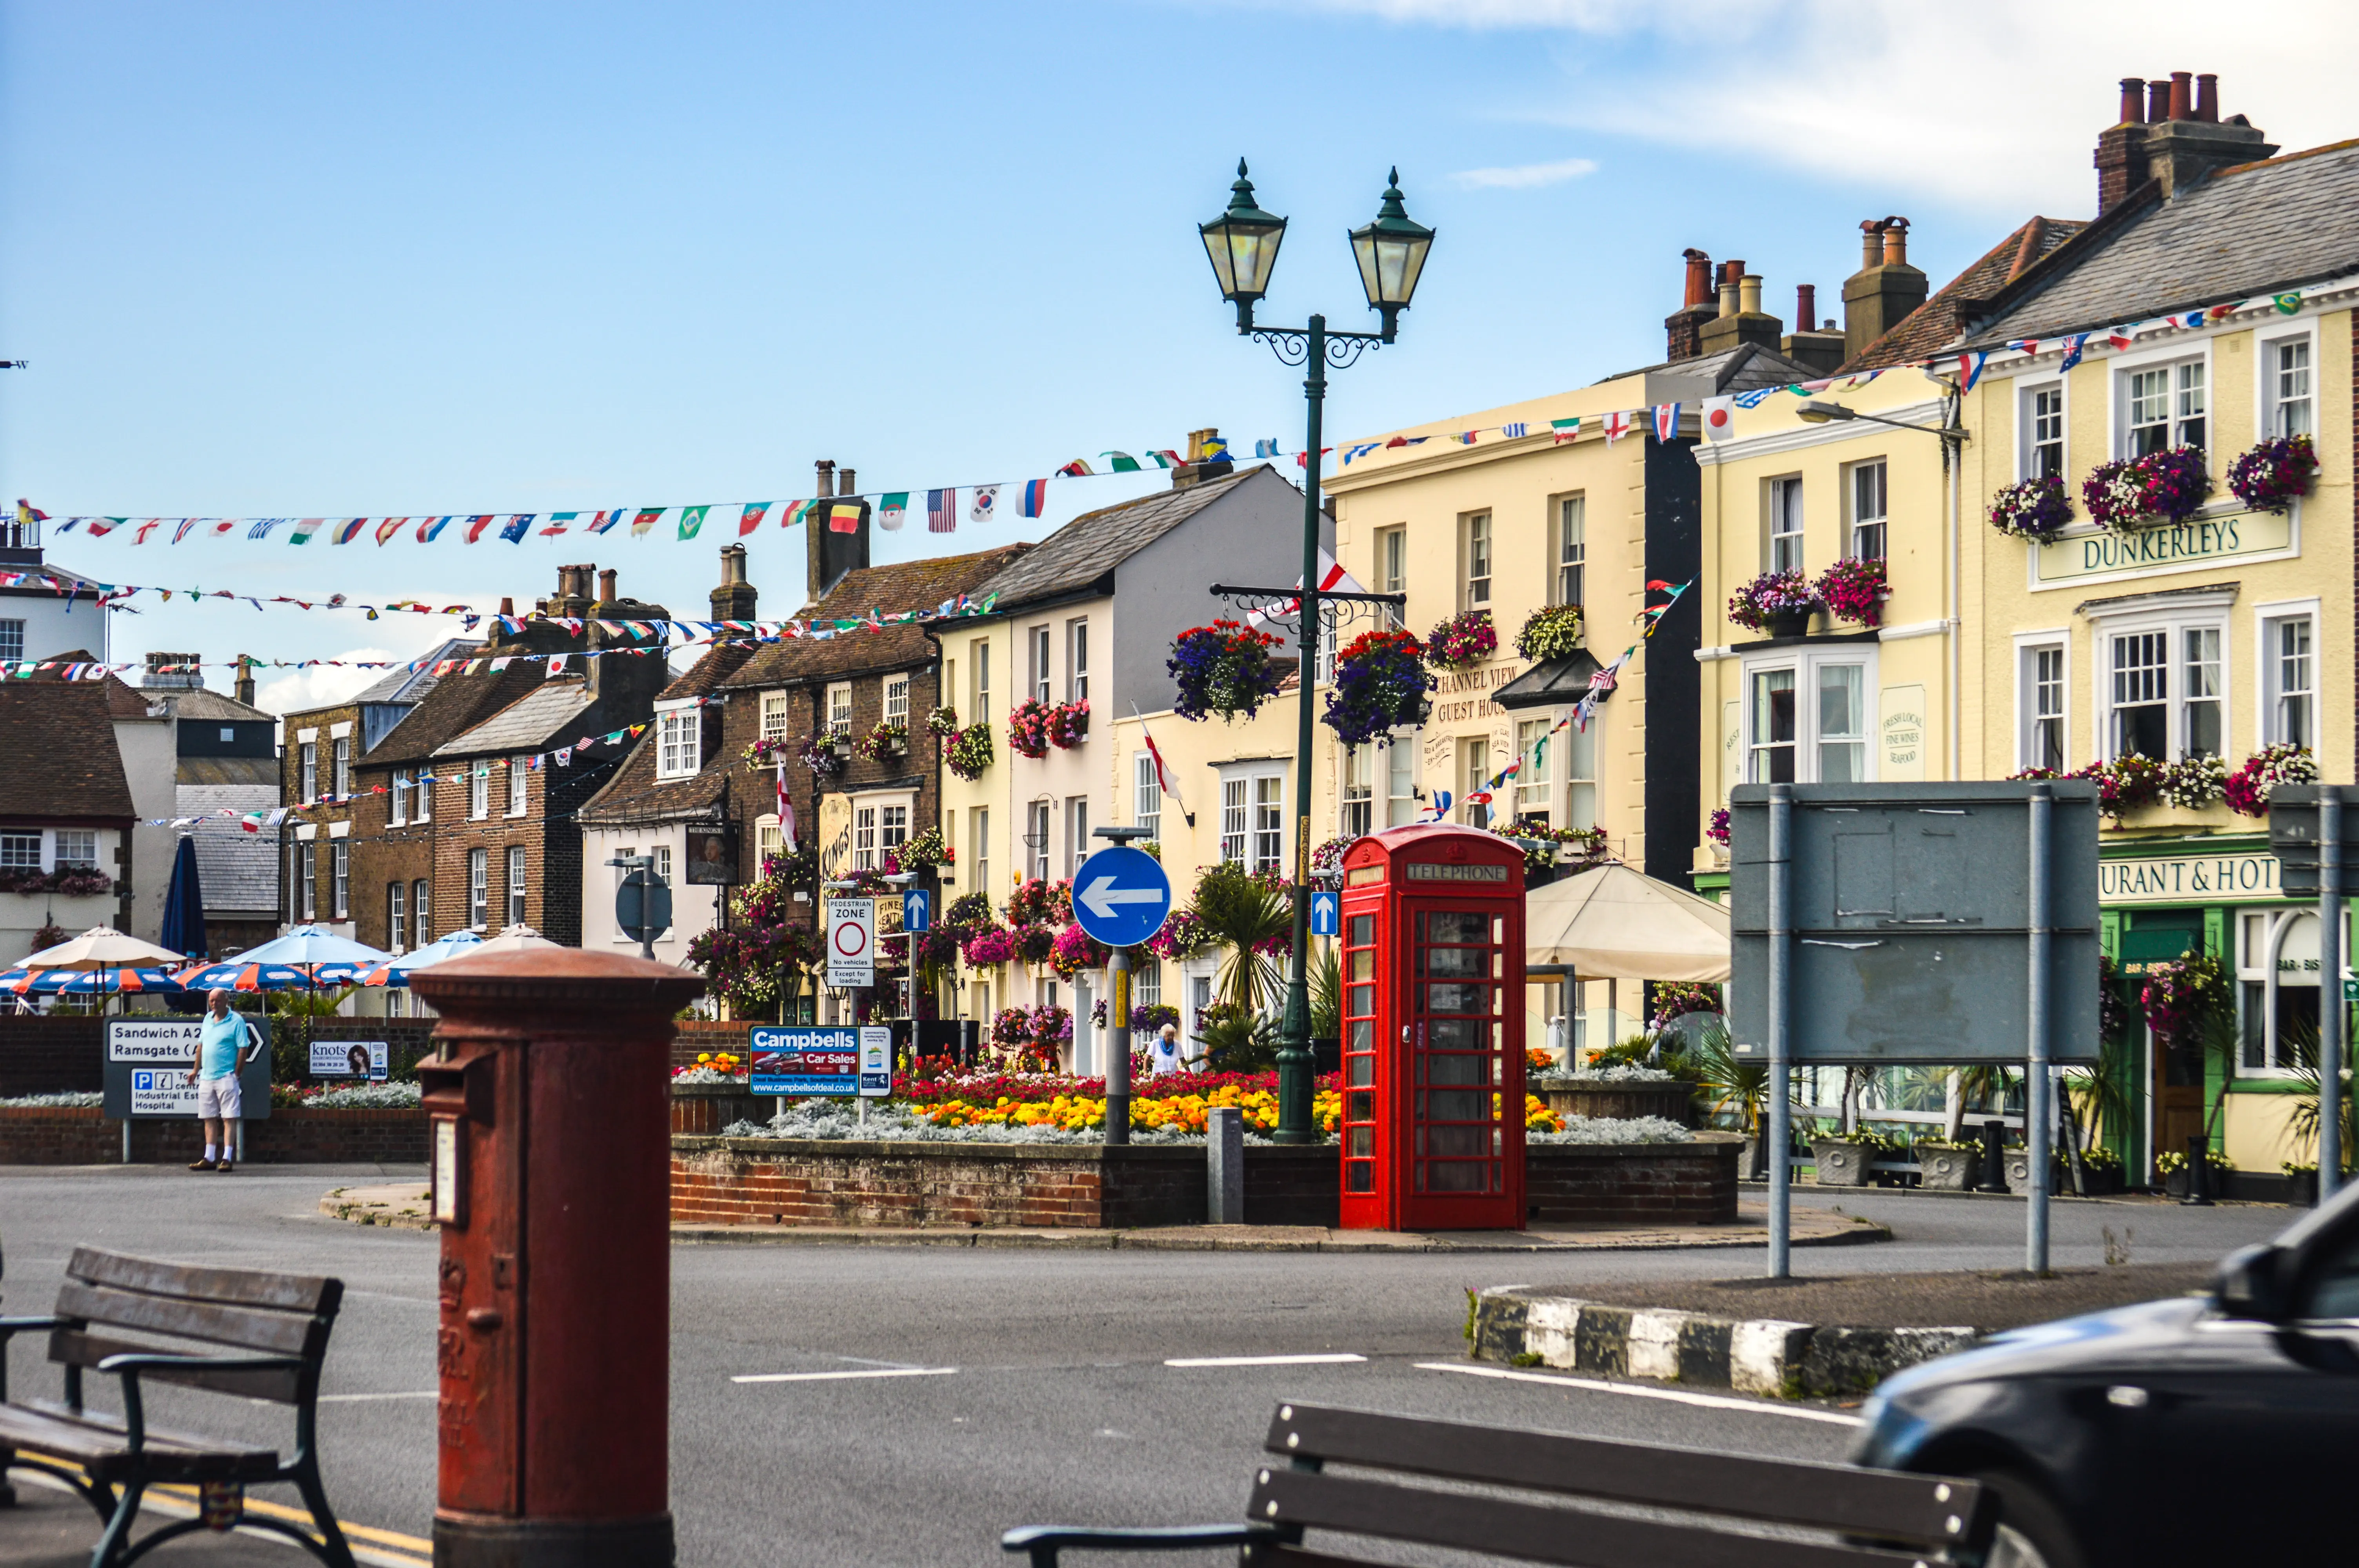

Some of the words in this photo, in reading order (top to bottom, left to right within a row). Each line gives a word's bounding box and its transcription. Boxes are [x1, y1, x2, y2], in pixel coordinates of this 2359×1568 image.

[2084, 519, 2239, 570] DUNKERLEYS
[1435, 671, 1488, 695] CHANNEL
[1490, 666, 1518, 688] VIEW
[1438, 701, 1474, 723] GUEST
[1883, 713, 1901, 731] FRESH
[1903, 712, 1922, 728] LOCAL
[1886, 734, 1899, 744] FINE
[1899, 732, 1919, 743] WINES
[1890, 750, 1916, 764] SEAFOOD
[829, 799, 839, 815] The
[821, 823, 850, 883] KINGS
[1410, 864, 1503, 880] TELEPHONE
[2192, 861, 2211, 891] &
[836, 909, 865, 918] ZONE
[2125, 963, 2142, 974] BAR
[2277, 959, 2296, 971] BAR
[114, 1027, 178, 1038] Sandwich
[754, 1031, 855, 1050] Campbells
[115, 1045, 179, 1058] Ramsgate
[312, 1043, 346, 1055] knots
[807, 1054, 825, 1064] Car
[828, 1054, 856, 1064] Sales
[753, 1083, 855, 1093] www.campbellsofdeal.co.uk
[135, 1101, 174, 1111] Hospital
